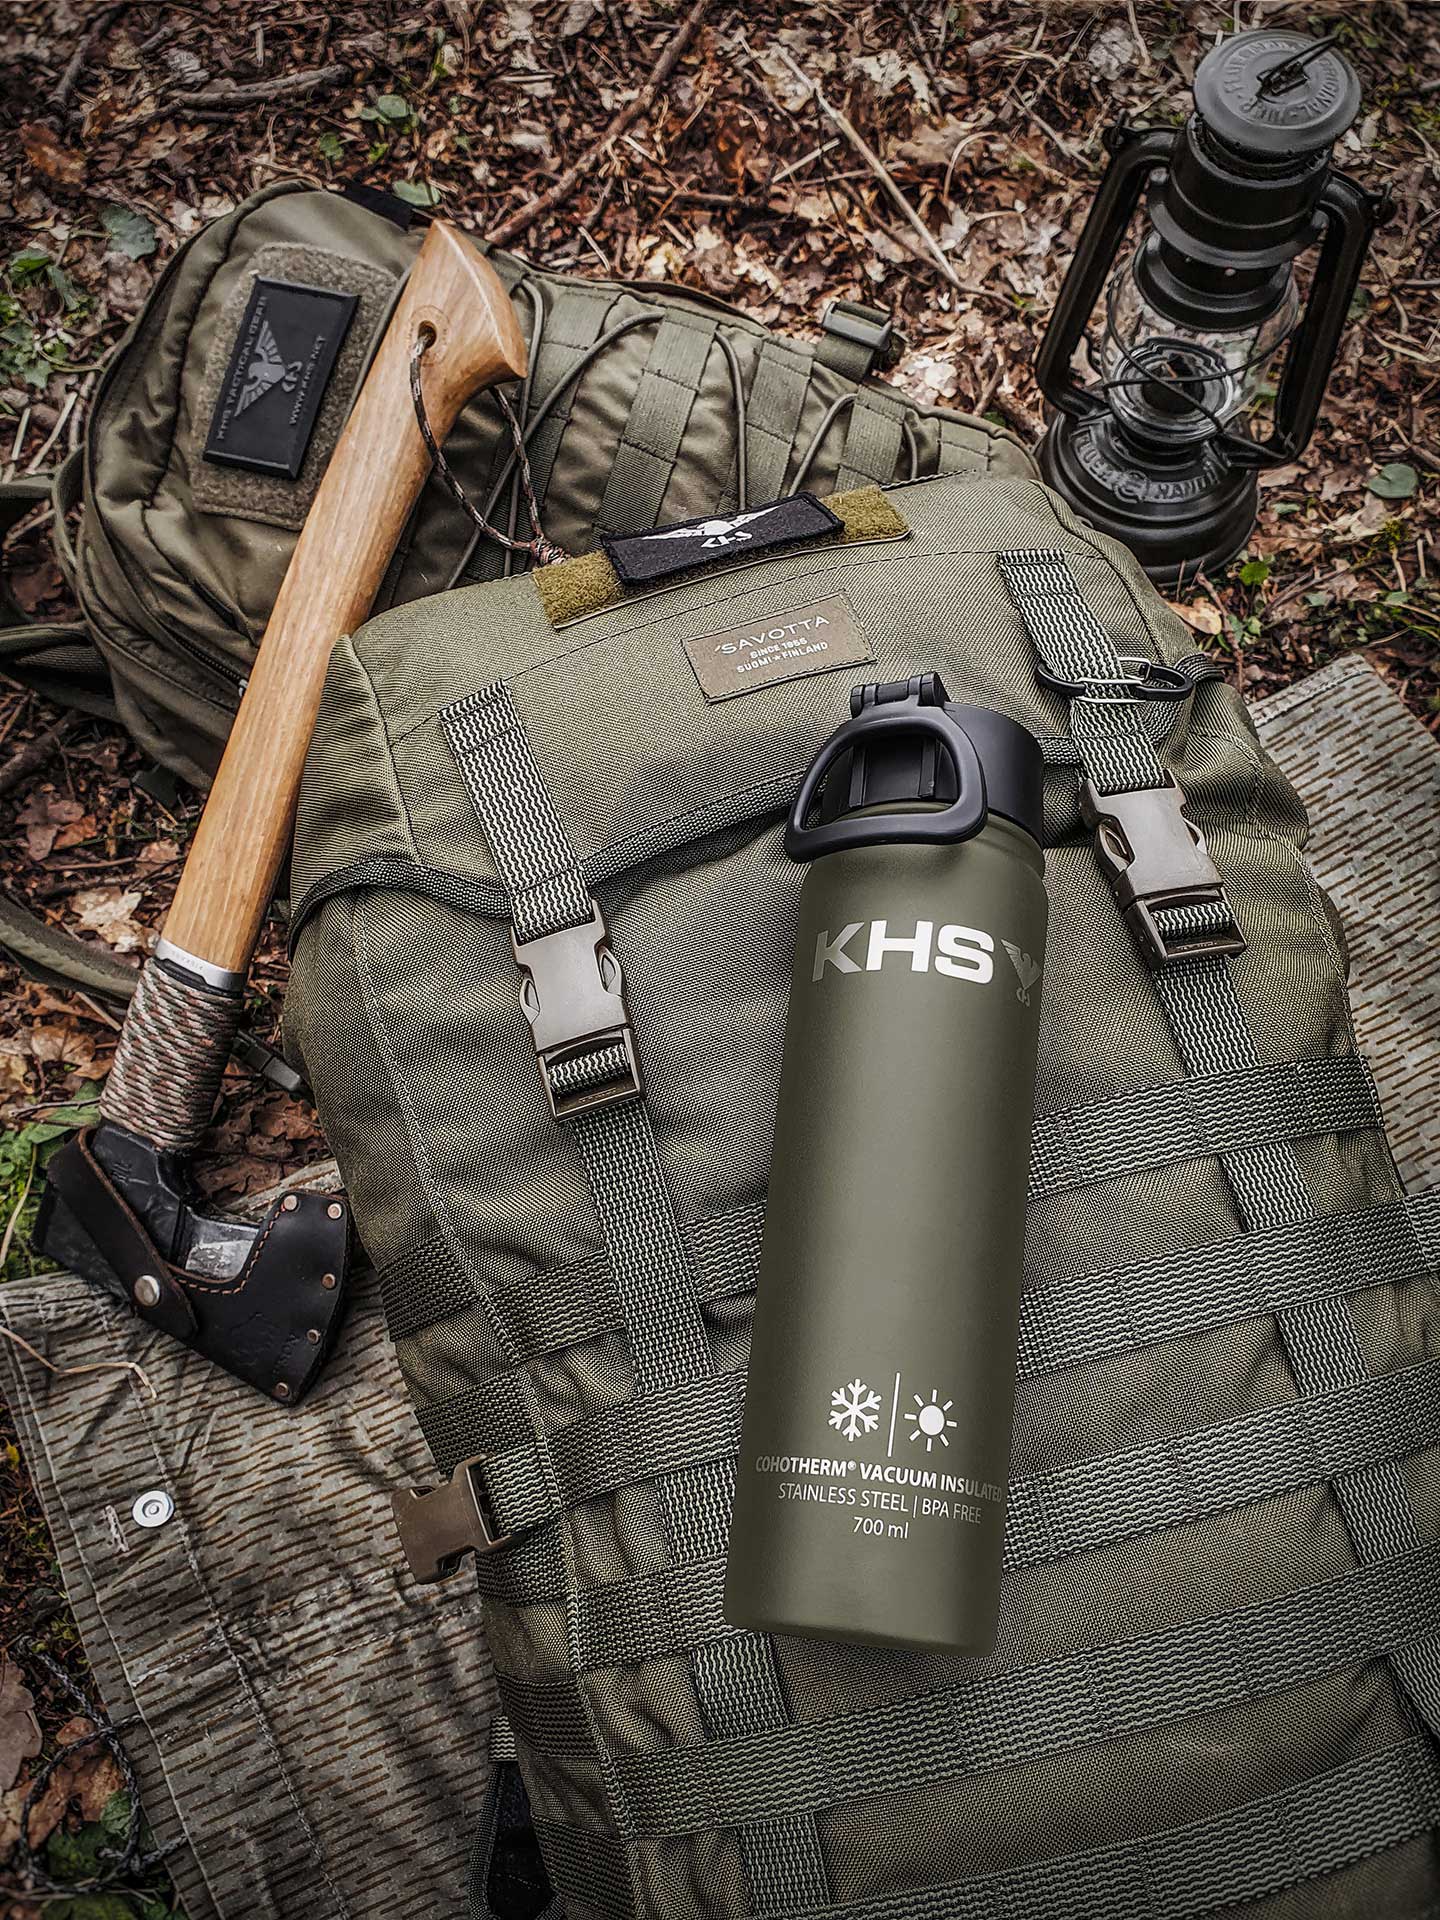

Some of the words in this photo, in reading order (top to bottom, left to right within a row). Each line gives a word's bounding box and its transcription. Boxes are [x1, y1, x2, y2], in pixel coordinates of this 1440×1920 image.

[228, 340, 253, 406] TACTICAL
[736, 657, 773, 674] SUOMI
[781, 641, 829, 659] FINLAND
[750, 644, 781, 659] SINCE
[811, 919, 995, 985] KHS
[860, 1462, 937, 1489] VACUUM
[940, 1474, 1002, 1503] INSULATED
[778, 1482, 857, 1506] STAINLESS
[860, 1490, 909, 1512] STEEL
[922, 1497, 950, 1519] BPA
[953, 1503, 982, 1525] FREE
[853, 1516, 884, 1536] 700
[888, 1521, 909, 1539] ml
